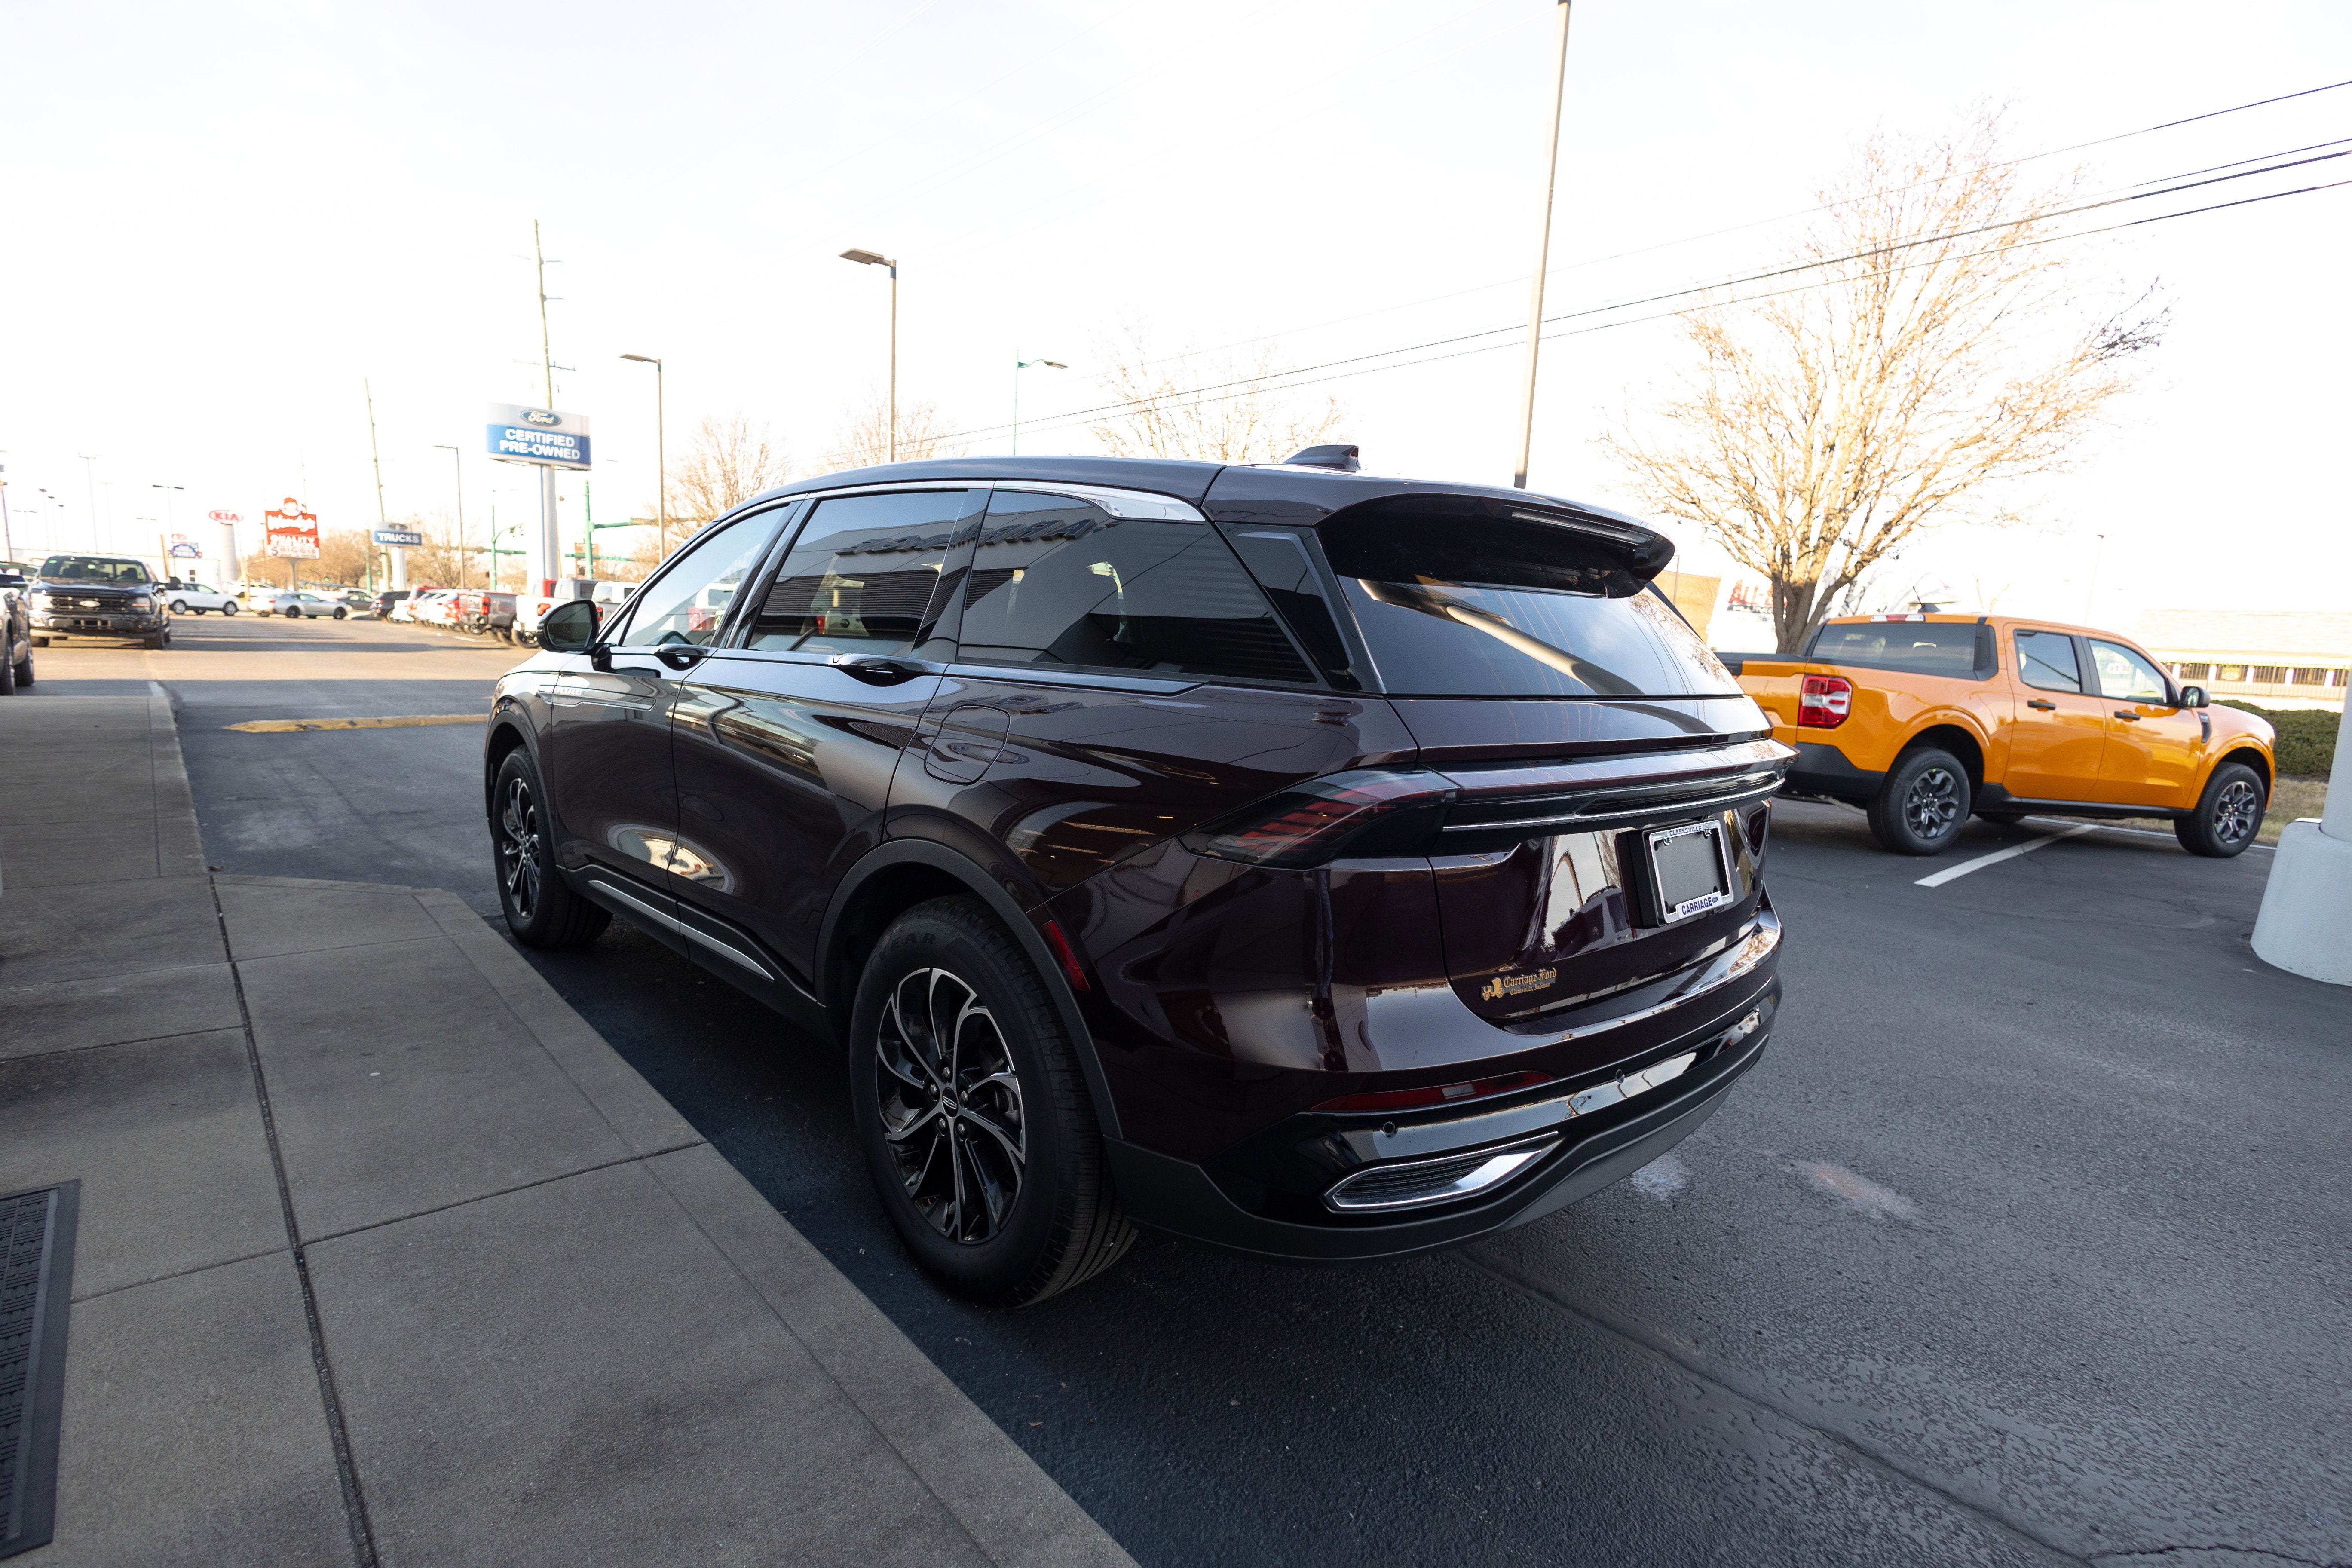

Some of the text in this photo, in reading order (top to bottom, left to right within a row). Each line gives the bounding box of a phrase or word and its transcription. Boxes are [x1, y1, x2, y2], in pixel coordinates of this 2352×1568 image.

[528, 410, 554, 424] Ford
[505, 429, 575, 447] CERTIFIED
[499, 440, 580, 460] PRE-OWNED
[215, 512, 238, 521] KIA
[267, 515, 316, 532] Wendy's
[377, 532, 420, 543] TRUCKS
[1669, 826, 1702, 836] CLARKSVILLE
[1681, 897, 1713, 915] CARRIAGE
[1504, 967, 1557, 988] Carriage Ford
